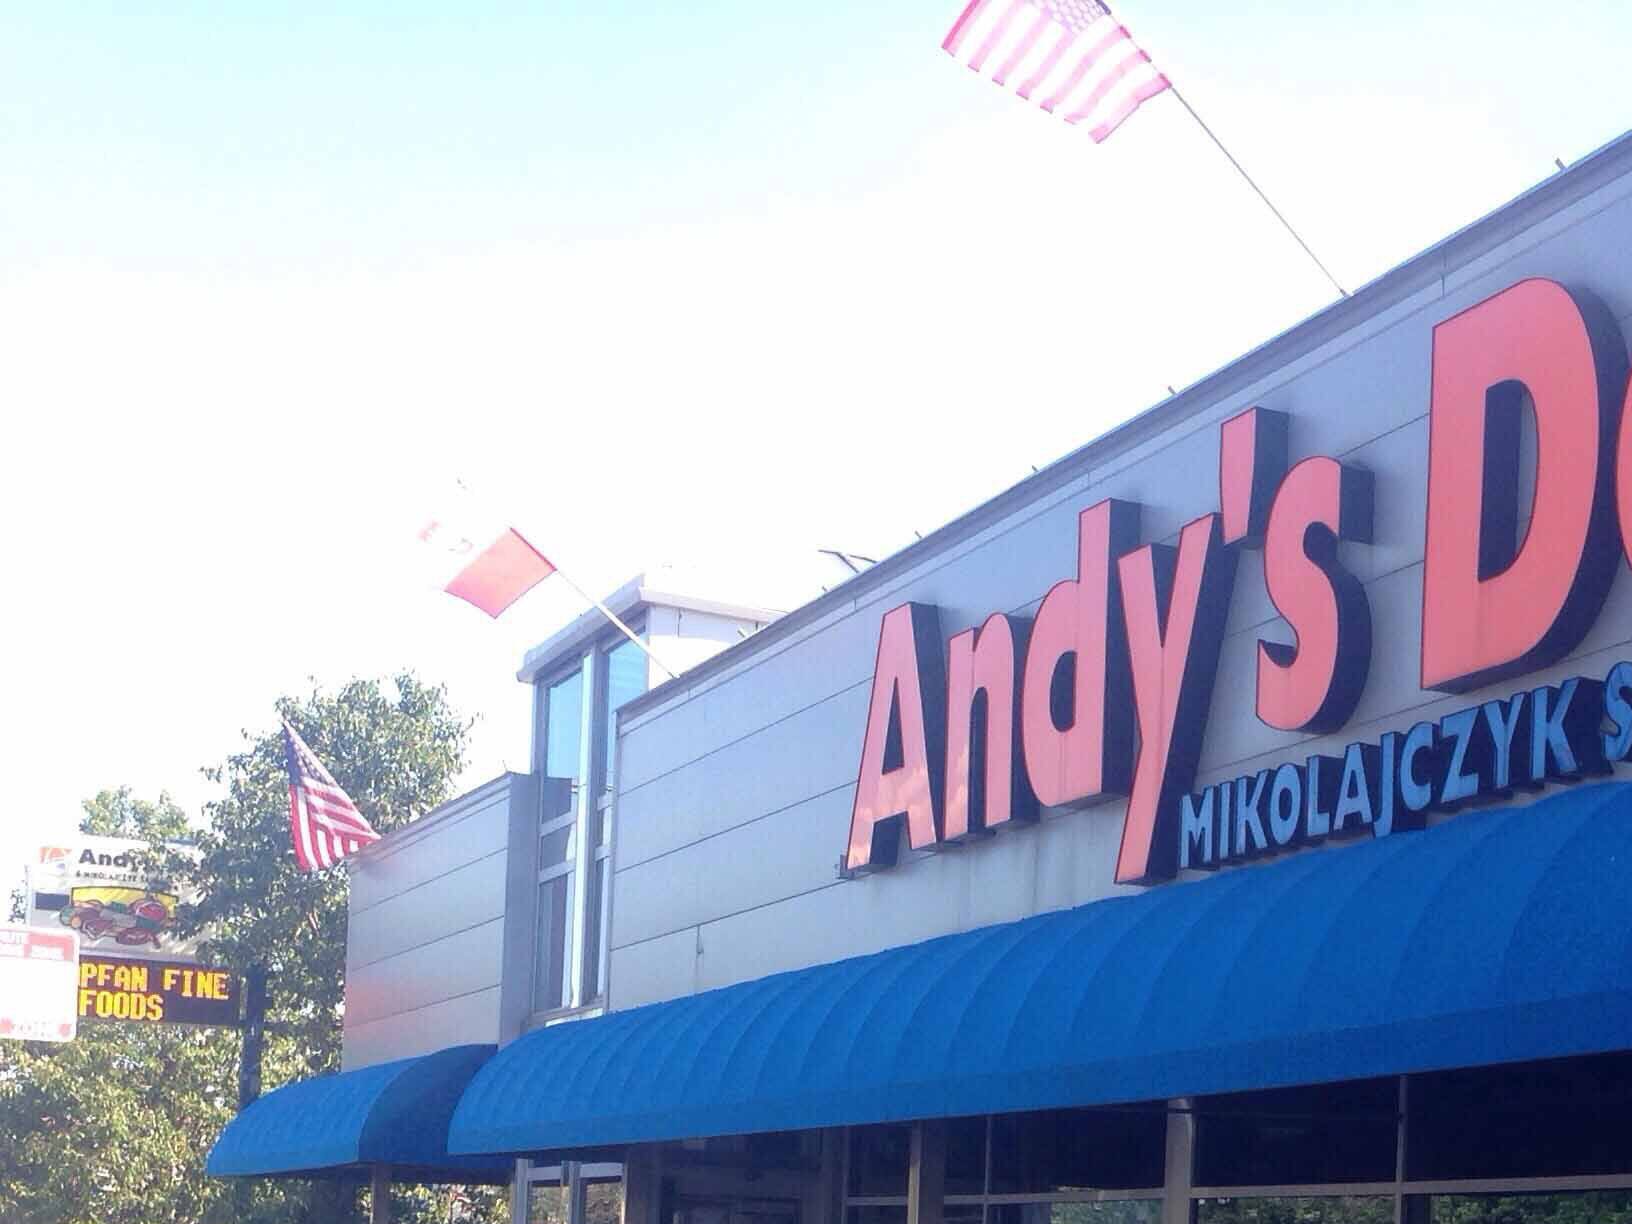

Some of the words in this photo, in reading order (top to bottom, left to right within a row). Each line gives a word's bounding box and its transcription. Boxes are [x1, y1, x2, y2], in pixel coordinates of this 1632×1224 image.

[845, 404, 1348, 886] Andy's
[1177, 675, 1584, 870] MIKOLAJCZYK
[79, 988, 164, 1021] FOODS
[163, 968, 230, 1001] FINE
